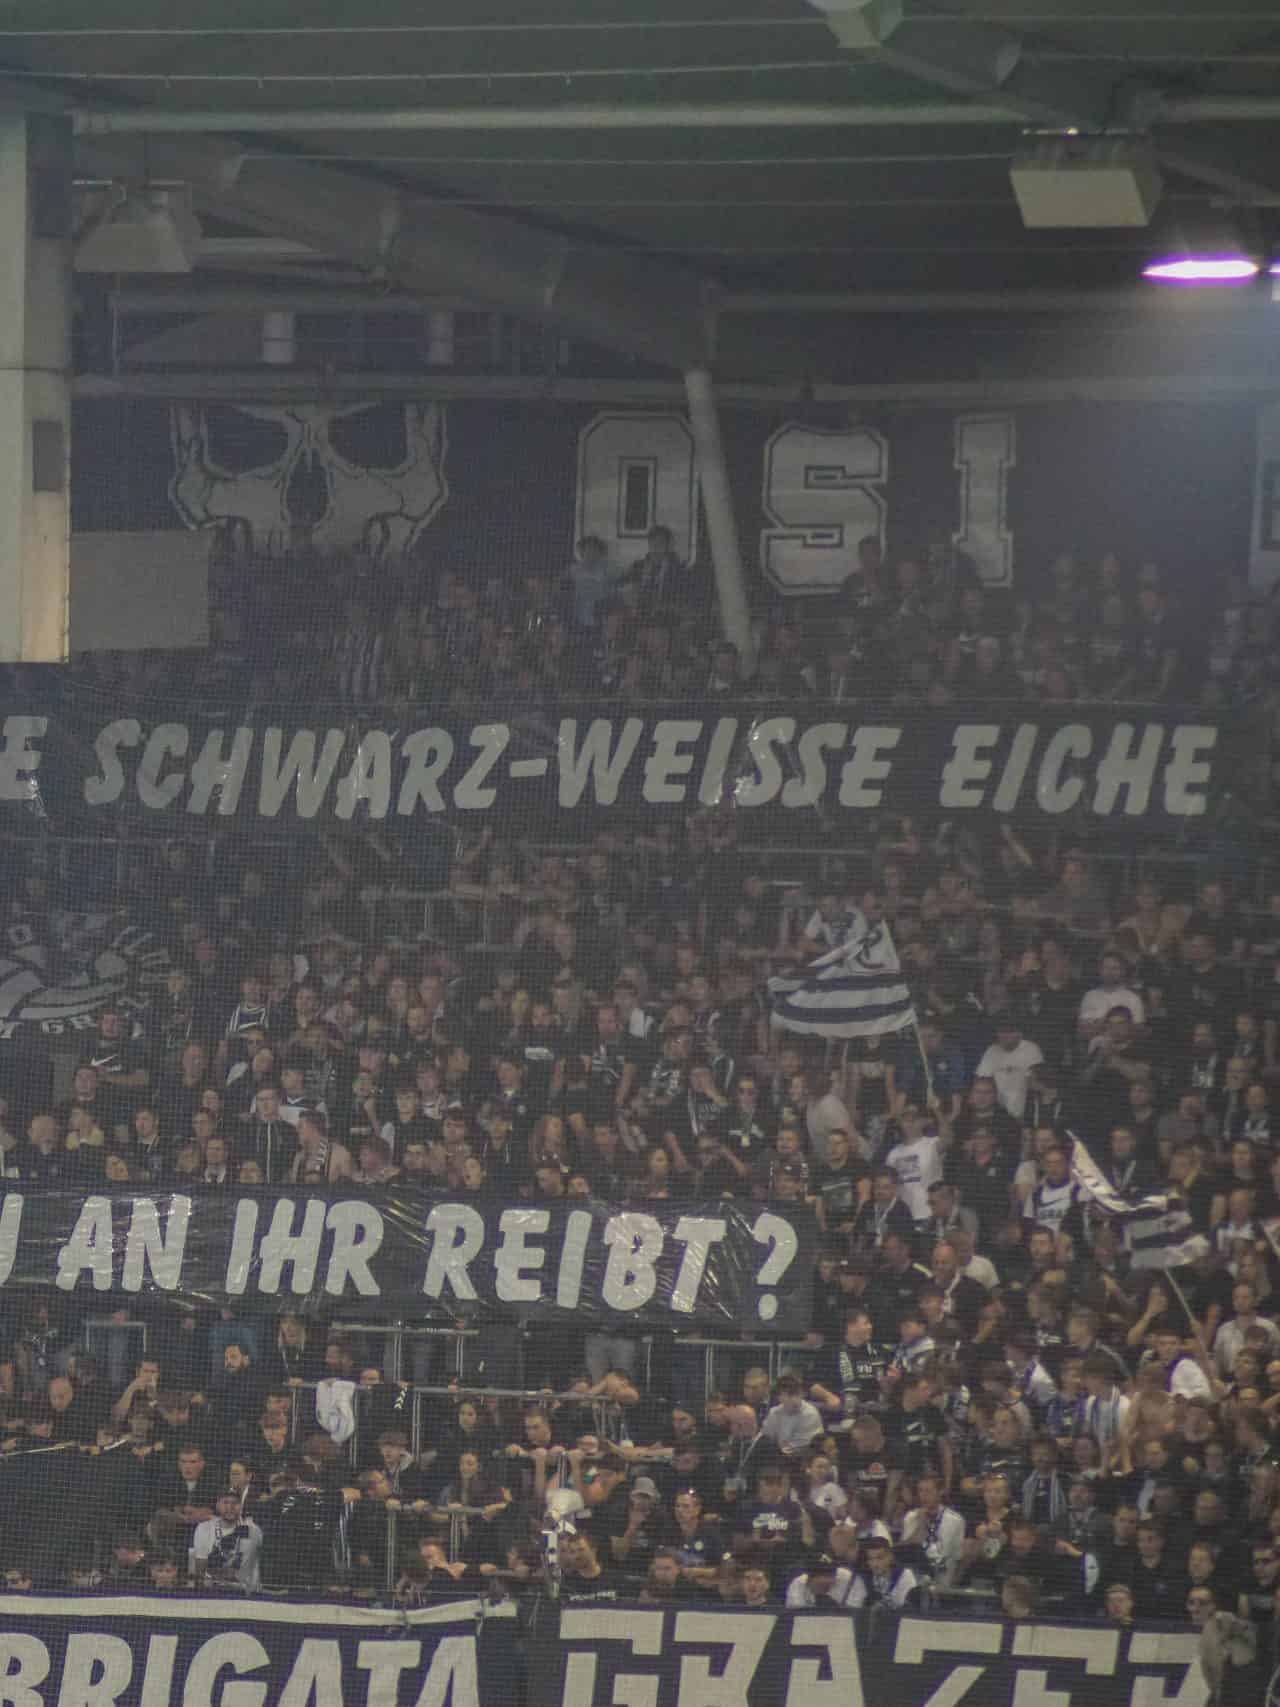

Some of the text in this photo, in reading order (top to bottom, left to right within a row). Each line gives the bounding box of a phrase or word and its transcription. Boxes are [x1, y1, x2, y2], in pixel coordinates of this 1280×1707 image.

[84, 717, 901, 818] SCHWARZ-WEISSE
[939, 723, 1219, 816] EICHE
[55, 1194, 192, 1291] AN
[225, 1197, 385, 1296] IHR
